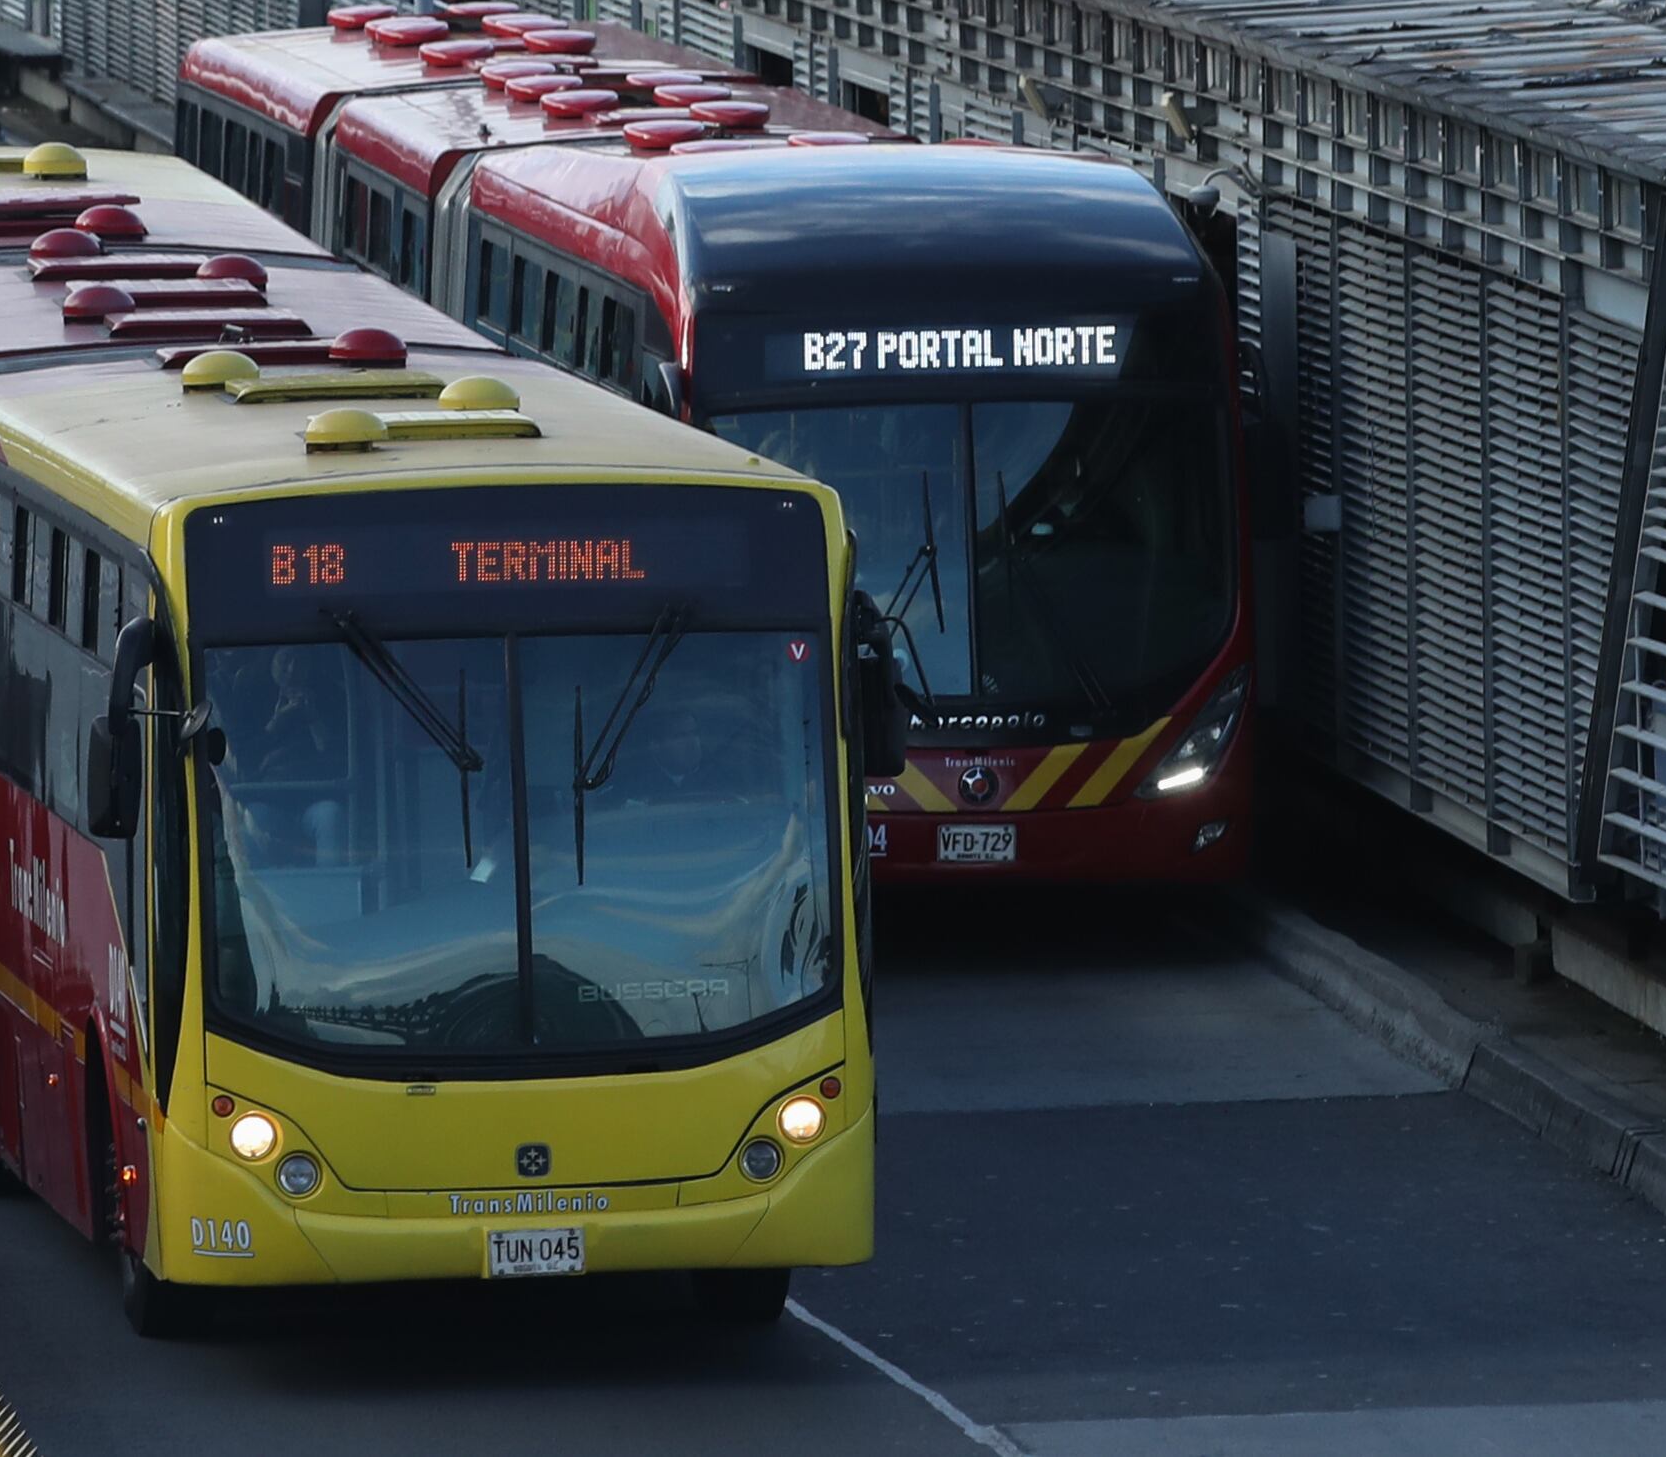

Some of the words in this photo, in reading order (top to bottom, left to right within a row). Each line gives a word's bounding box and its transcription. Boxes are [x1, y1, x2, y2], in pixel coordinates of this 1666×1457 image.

[803, 330, 868, 371] B27
[877, 328, 1004, 370] PORTAL
[1012, 325, 1117, 368] NORTE
[271, 543, 346, 585] B18
[451, 538, 645, 583] TERMINAL
[941, 831, 1013, 852] VFD-729
[578, 979, 729, 1003] BUSSCAR
[448, 1192, 611, 1215] TransMilenio
[190, 1217, 252, 1250] D140
